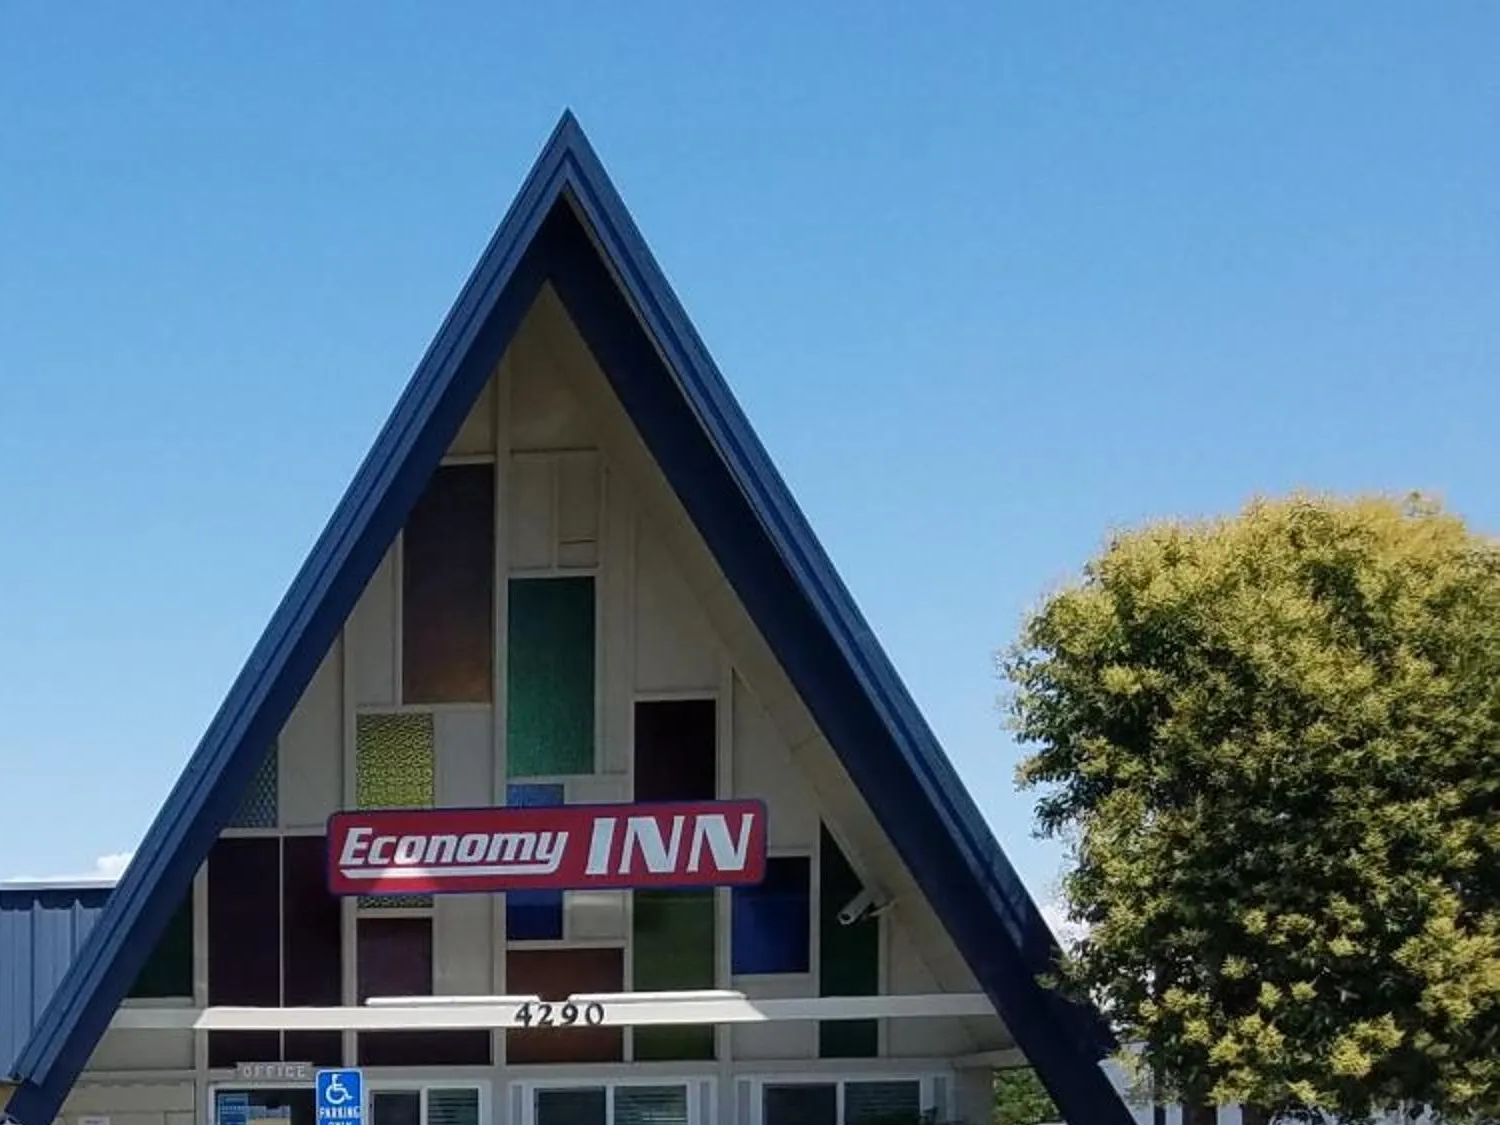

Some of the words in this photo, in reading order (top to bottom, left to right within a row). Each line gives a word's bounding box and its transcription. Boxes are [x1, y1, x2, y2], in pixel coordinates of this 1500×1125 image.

[339, 825, 569, 876] Economy
[585, 813, 755, 875] INN
[514, 1001, 605, 1028] 4290
[242, 1064, 306, 1079] OFFICE
[319, 1105, 361, 1118] PARKING
